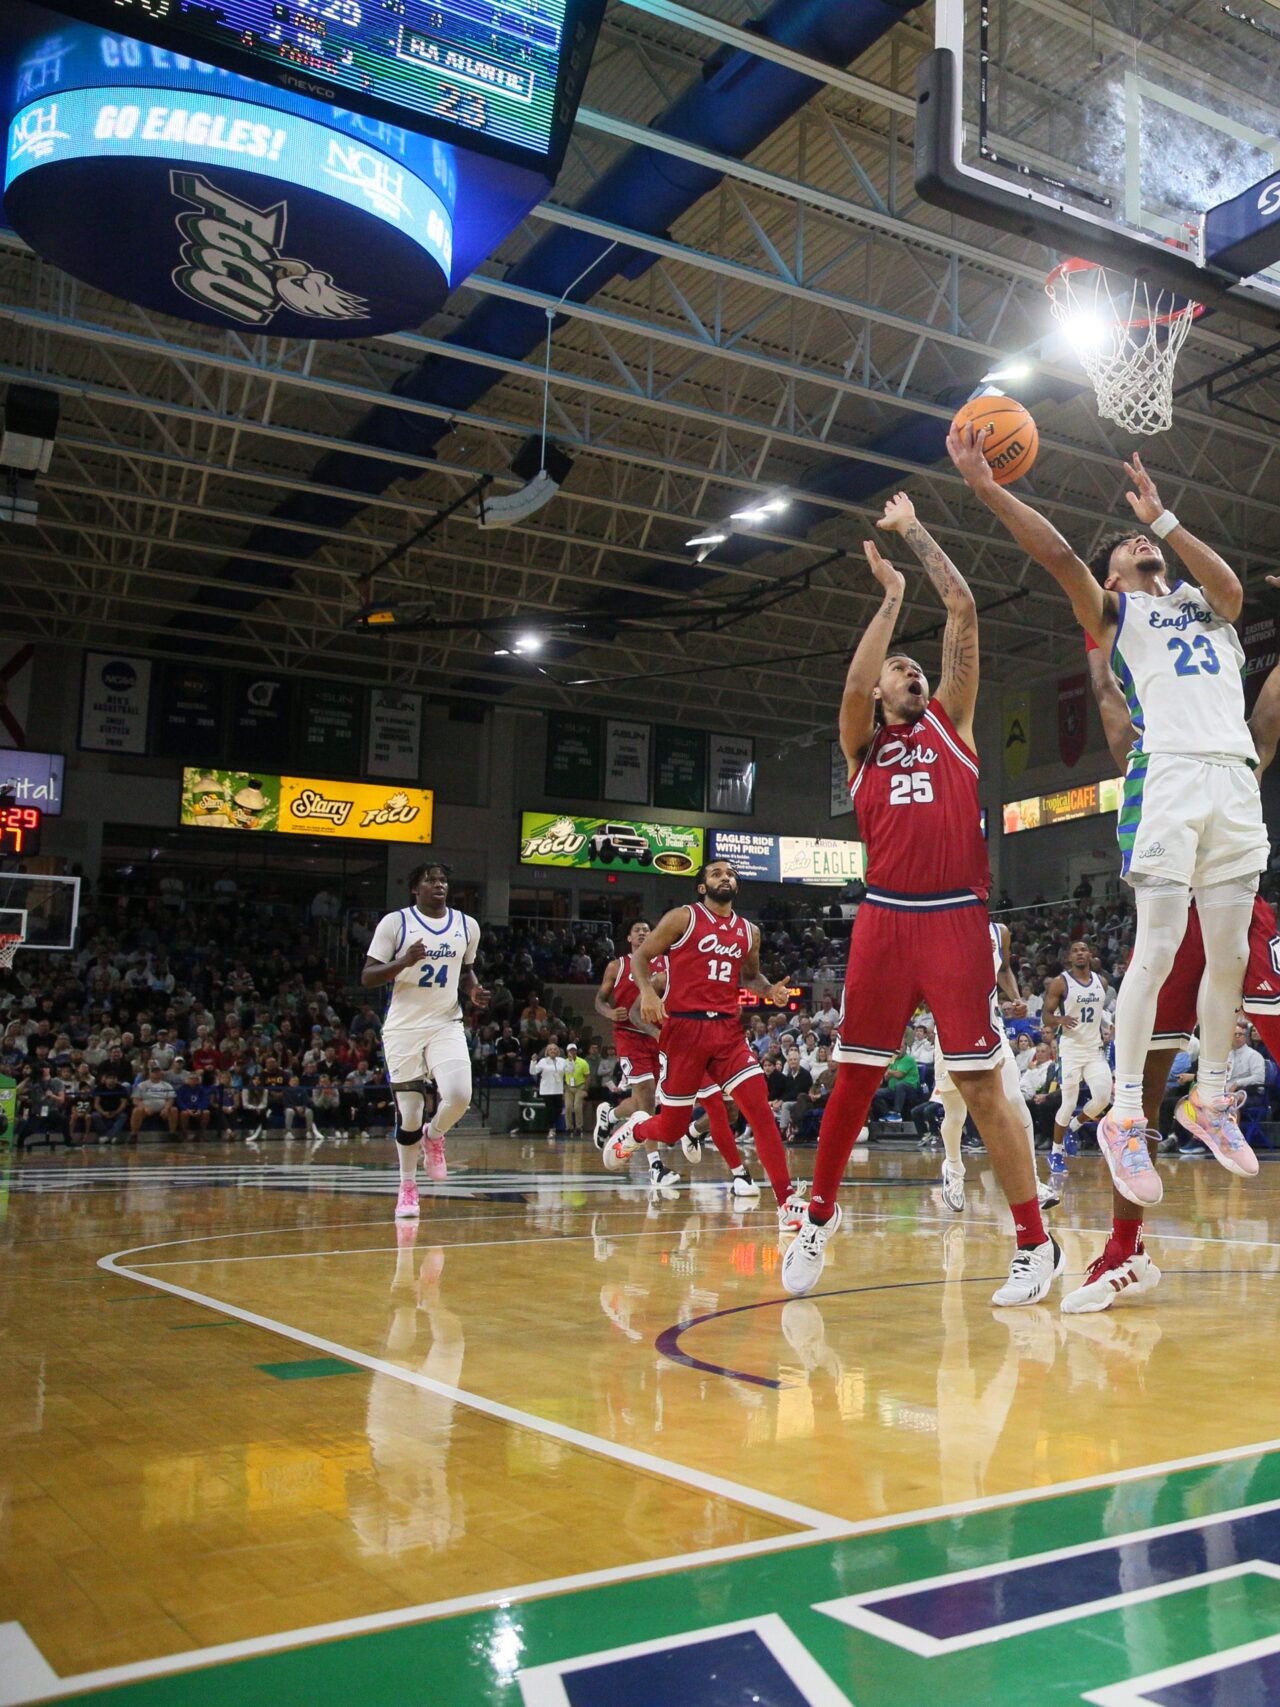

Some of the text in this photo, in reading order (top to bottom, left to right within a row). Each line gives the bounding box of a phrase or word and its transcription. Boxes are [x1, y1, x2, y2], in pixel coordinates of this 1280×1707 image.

[410, 37, 524, 91] FLA ATLANTIC
[94, 104, 286, 161] GO EAGLES!
[1149, 602, 1212, 631] Eagles
[1245, 618, 1274, 635] EASTERN
[1244, 629, 1276, 645] KENTUCKY
[1167, 635, 1220, 677] 23
[1247, 653, 1277, 671] EKU
[889, 771, 934, 806] 25
[1042, 786, 1097, 811] tropical CAFE
[291, 789, 354, 826] Starry
[359, 806, 420, 827] FGCU
[521, 833, 587, 859] FGCU
[716, 833, 774, 846] EAGLES RIDE
[716, 843, 770, 855] WITH PRIDE
[806, 840, 838, 848] FLORIDA
[813, 851, 858, 874] EAGLE
[425, 943, 457, 960] agles
[698, 933, 742, 959] Owls
[418, 964, 449, 988] 24
[707, 959, 732, 983] 12
[1080, 1007, 1095, 1023] 12
